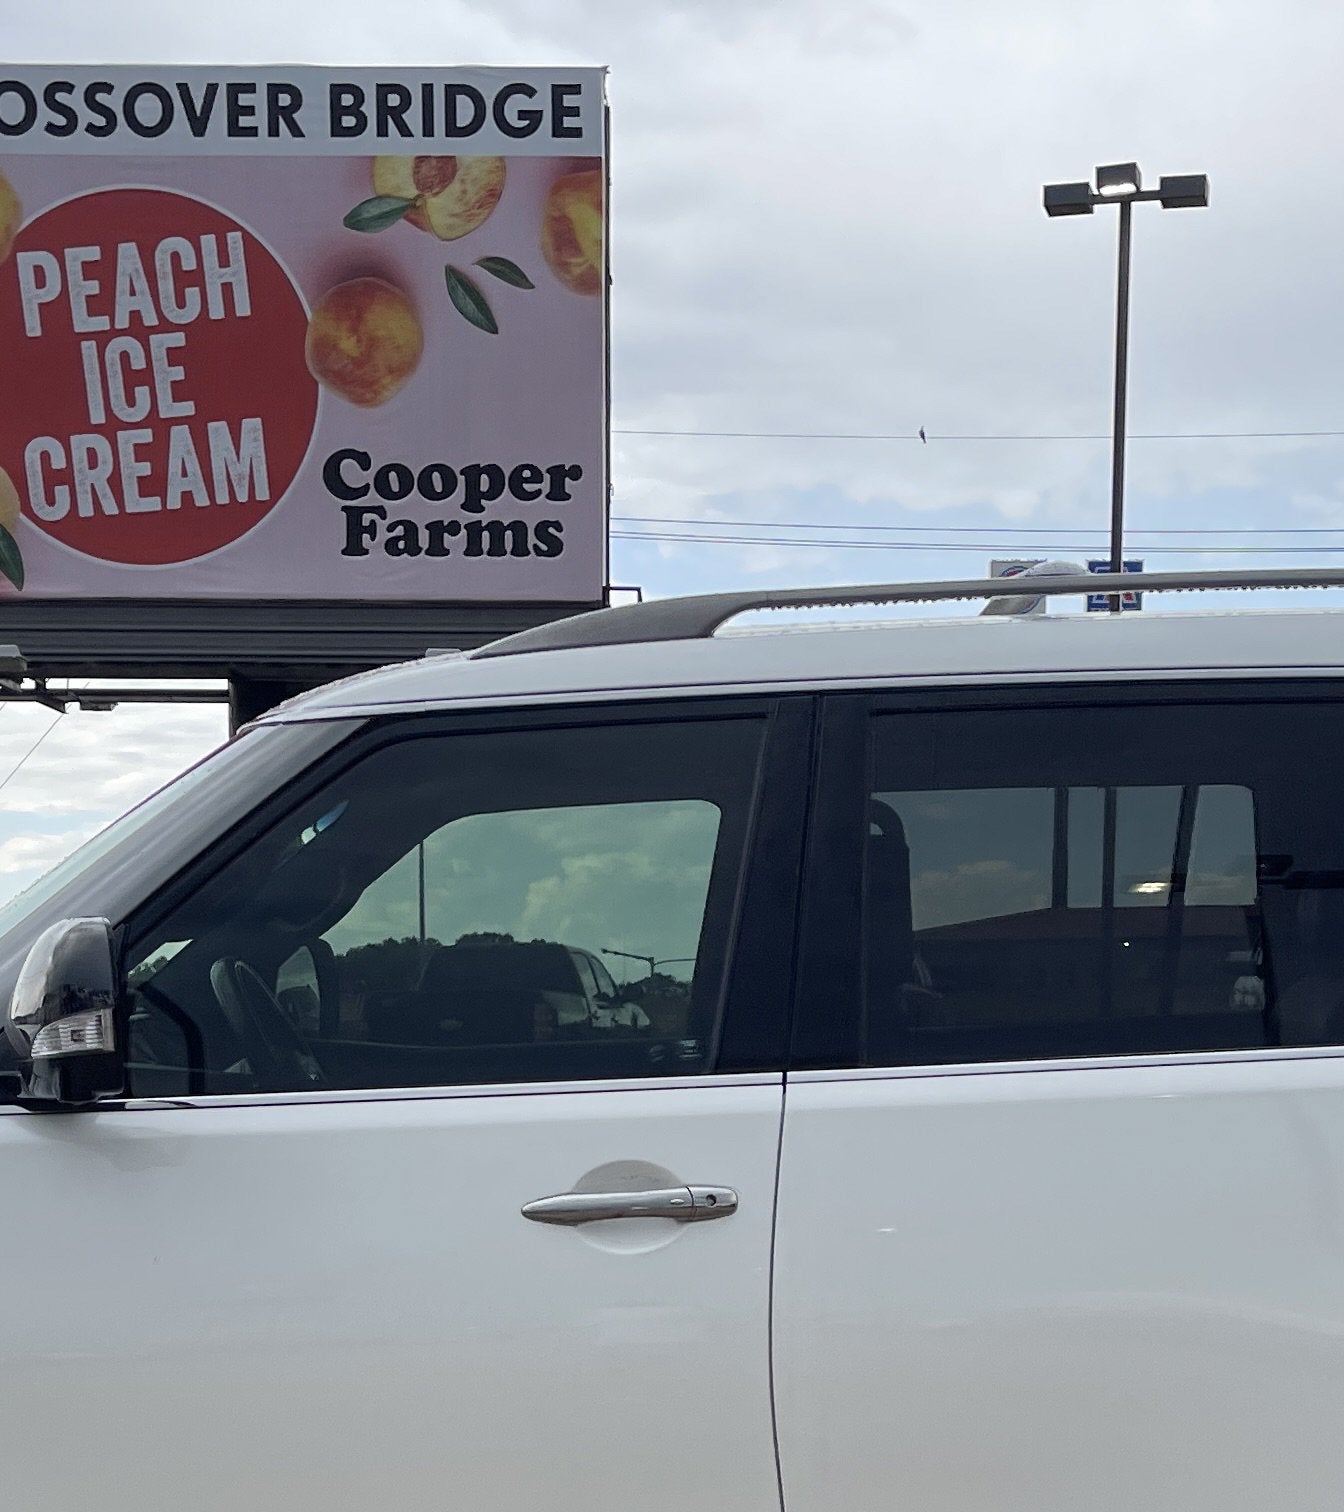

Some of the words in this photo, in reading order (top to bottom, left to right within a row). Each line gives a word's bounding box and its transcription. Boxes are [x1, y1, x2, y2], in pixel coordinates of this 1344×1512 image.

[329, 82, 583, 138] BRIDGE
[16, 231, 251, 337] PEACH
[80, 332, 195, 424] ICE
[24, 417, 270, 522] CREAM
[323, 448, 583, 513] Cooper
[341, 505, 564, 558] Farms
